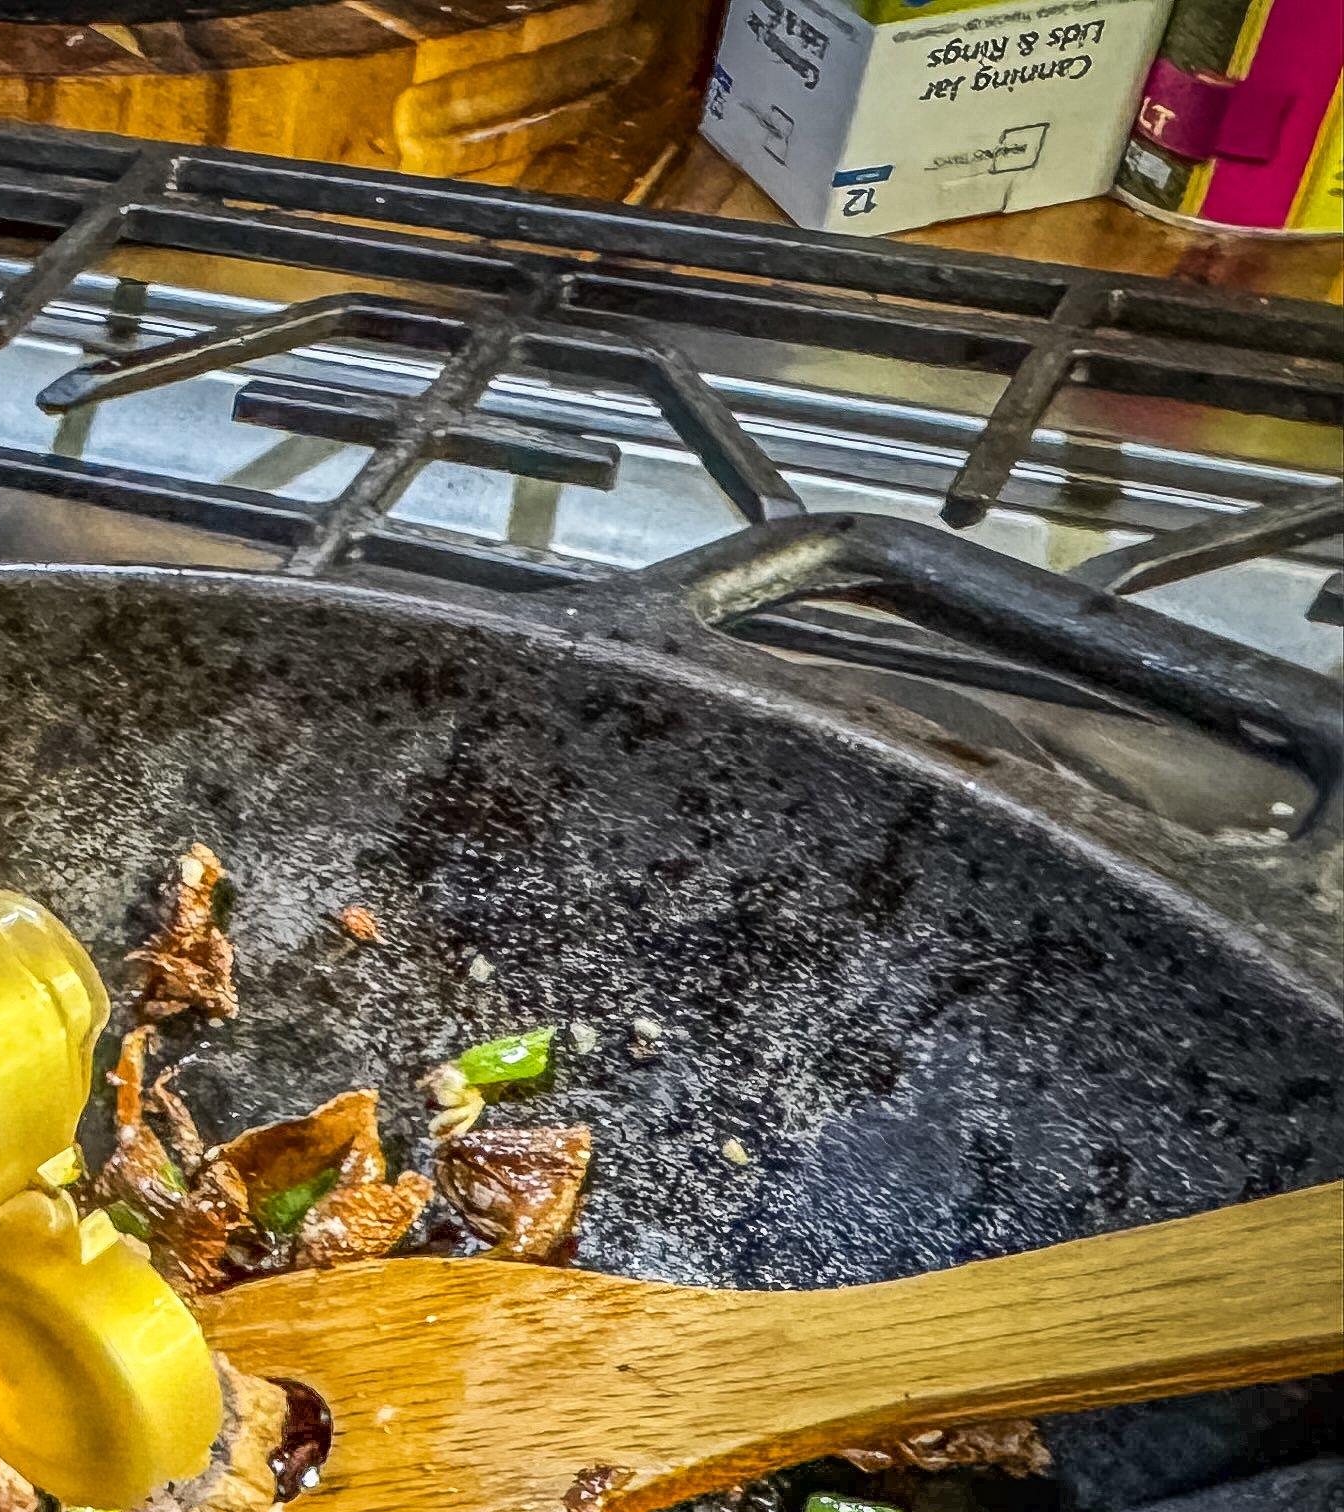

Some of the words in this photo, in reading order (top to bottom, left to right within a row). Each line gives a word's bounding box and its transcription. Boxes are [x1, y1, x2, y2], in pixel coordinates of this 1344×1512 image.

[1017, 33, 1043, 54] &
[1047, 20, 1105, 50] Lids
[927, 38, 1008, 67] Rings
[970, 55, 1092, 92] Canning
[919, 76, 958, 102] Jar
[842, 188, 878, 217] 12
